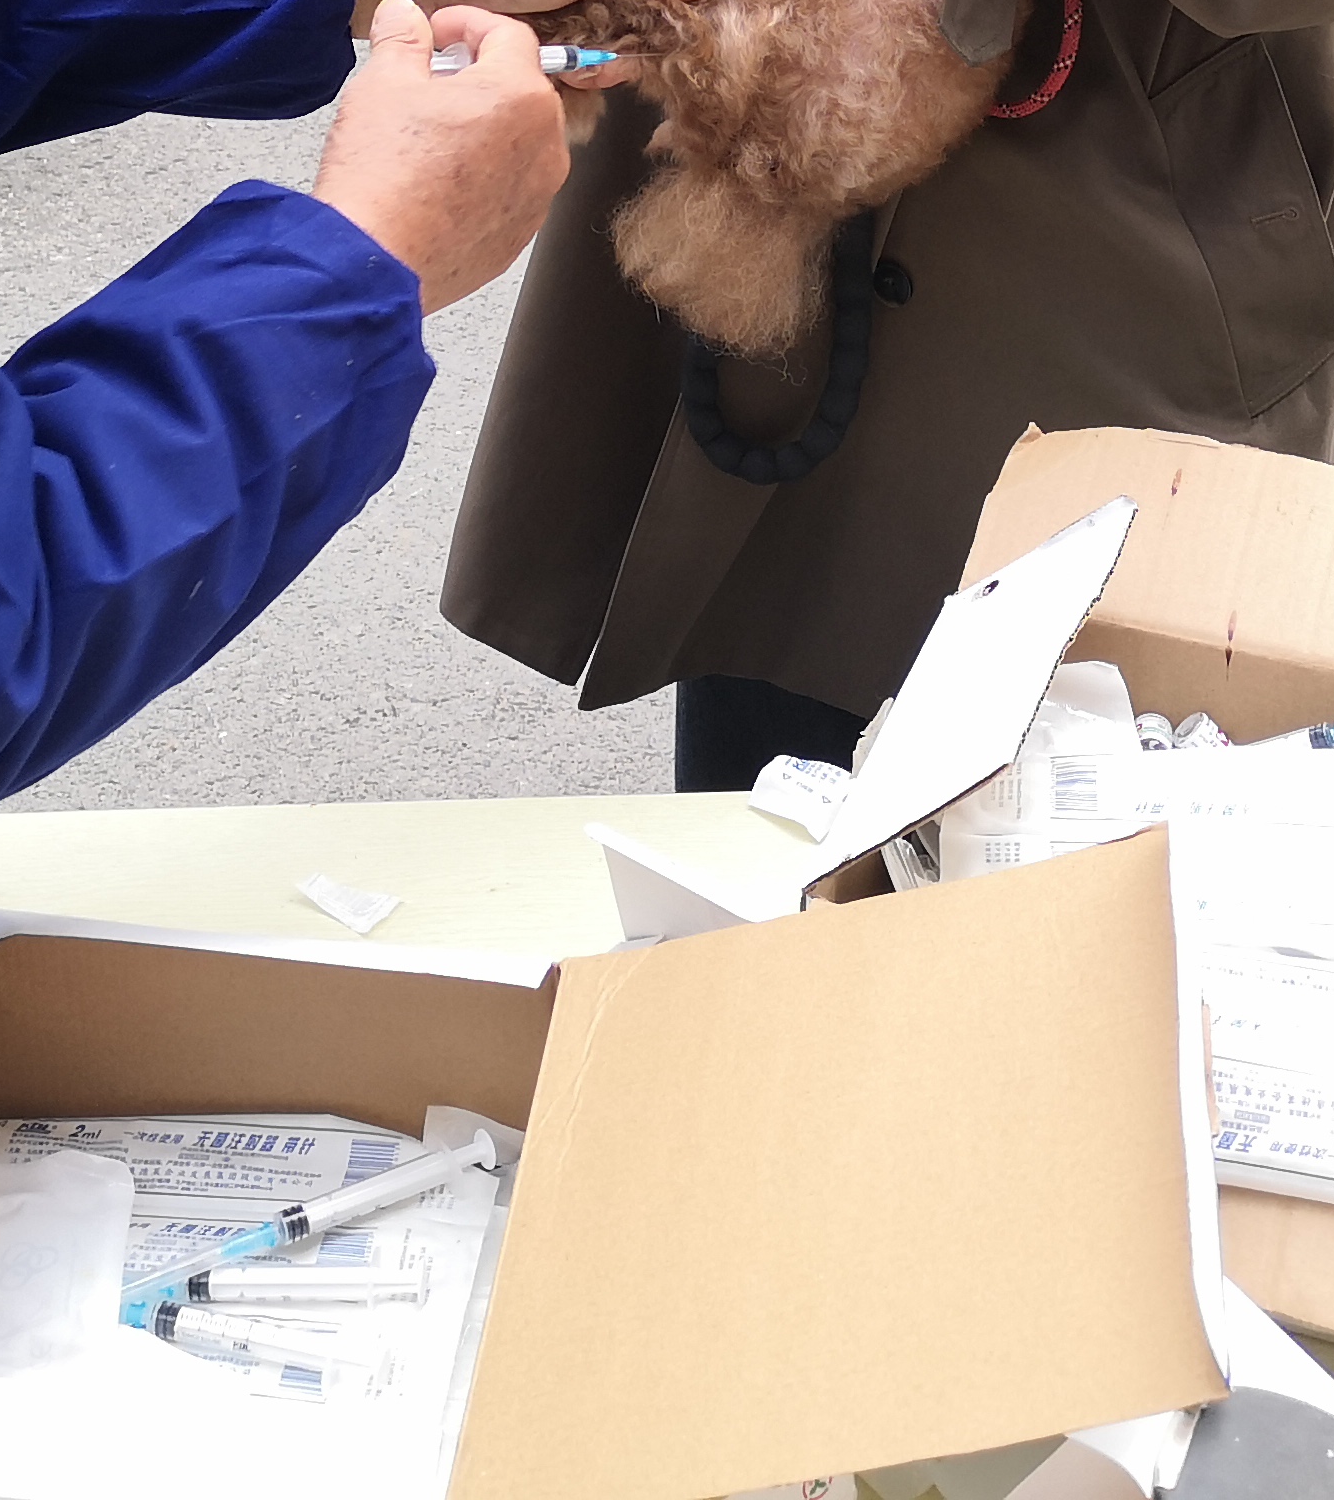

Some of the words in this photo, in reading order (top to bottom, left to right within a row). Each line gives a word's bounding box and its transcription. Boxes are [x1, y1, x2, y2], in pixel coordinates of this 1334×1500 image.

[68, 1124, 102, 1139] 2ml
[123, 1131, 185, 1145] 一次性使用
[192, 1131, 279, 1153] 无菌注射器
[281, 1137, 316, 1155] 带针
